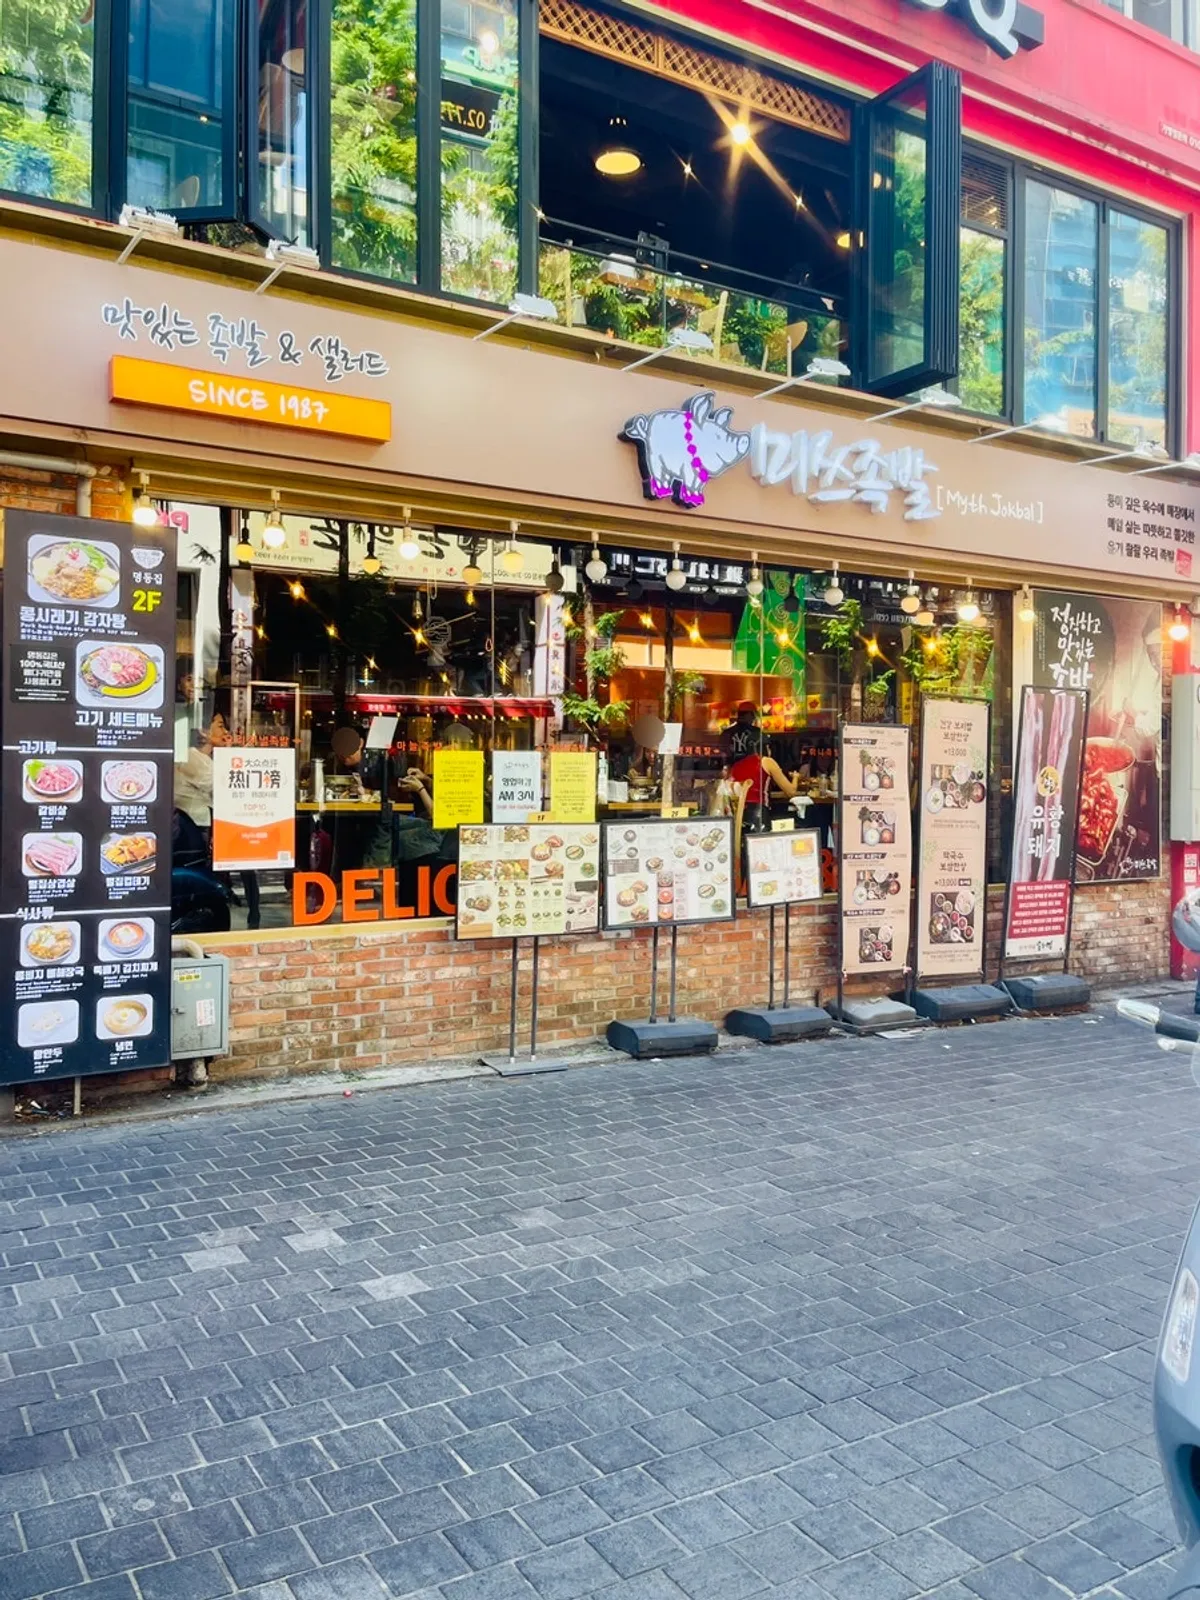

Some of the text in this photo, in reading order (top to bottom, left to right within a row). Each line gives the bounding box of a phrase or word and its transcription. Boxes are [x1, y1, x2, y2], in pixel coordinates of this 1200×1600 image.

[102, 297, 390, 382] 맛있는 족발 & 샐러드
[188, 379, 330, 424] SINCE 1987
[1143, 523, 1172, 539] 따뜻하고
[1173, 527, 1195, 544] 쫄깃한
[1143, 546, 1158, 561] 우리
[132, 590, 162, 611] 2F
[83, 611, 127, 629] 감자탕
[1051, 602, 1102, 635] 정직하고
[1058, 634, 1096, 666] 맛있는
[75, 710, 163, 728] 고기 세트메뉴
[228, 770, 282, 788] 热门榜
[498, 790, 535, 801] AM 3시
